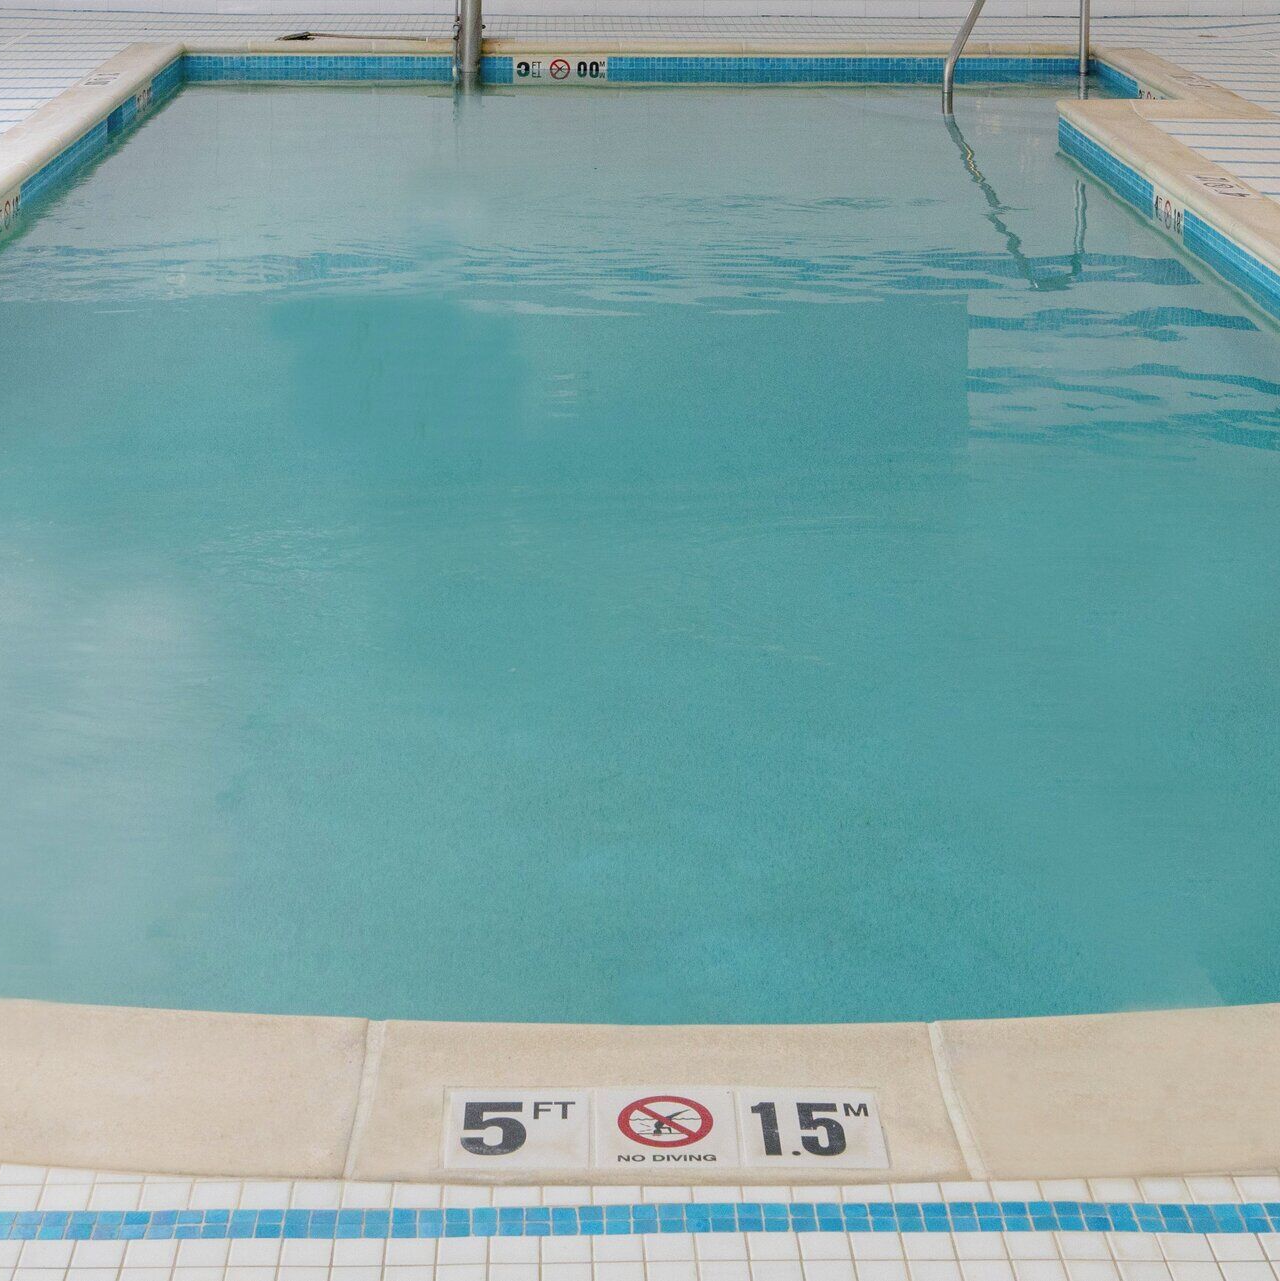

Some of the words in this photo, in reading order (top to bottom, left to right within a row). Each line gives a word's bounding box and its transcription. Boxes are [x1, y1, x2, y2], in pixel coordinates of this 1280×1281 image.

[460, 1101, 527, 1157] 5
[533, 1101, 576, 1120] FT
[617, 1154, 646, 1163] NO
[652, 1153, 717, 1163] DIVING
[750, 1101, 847, 1157] 1.5
[844, 1102, 869, 1118] M
